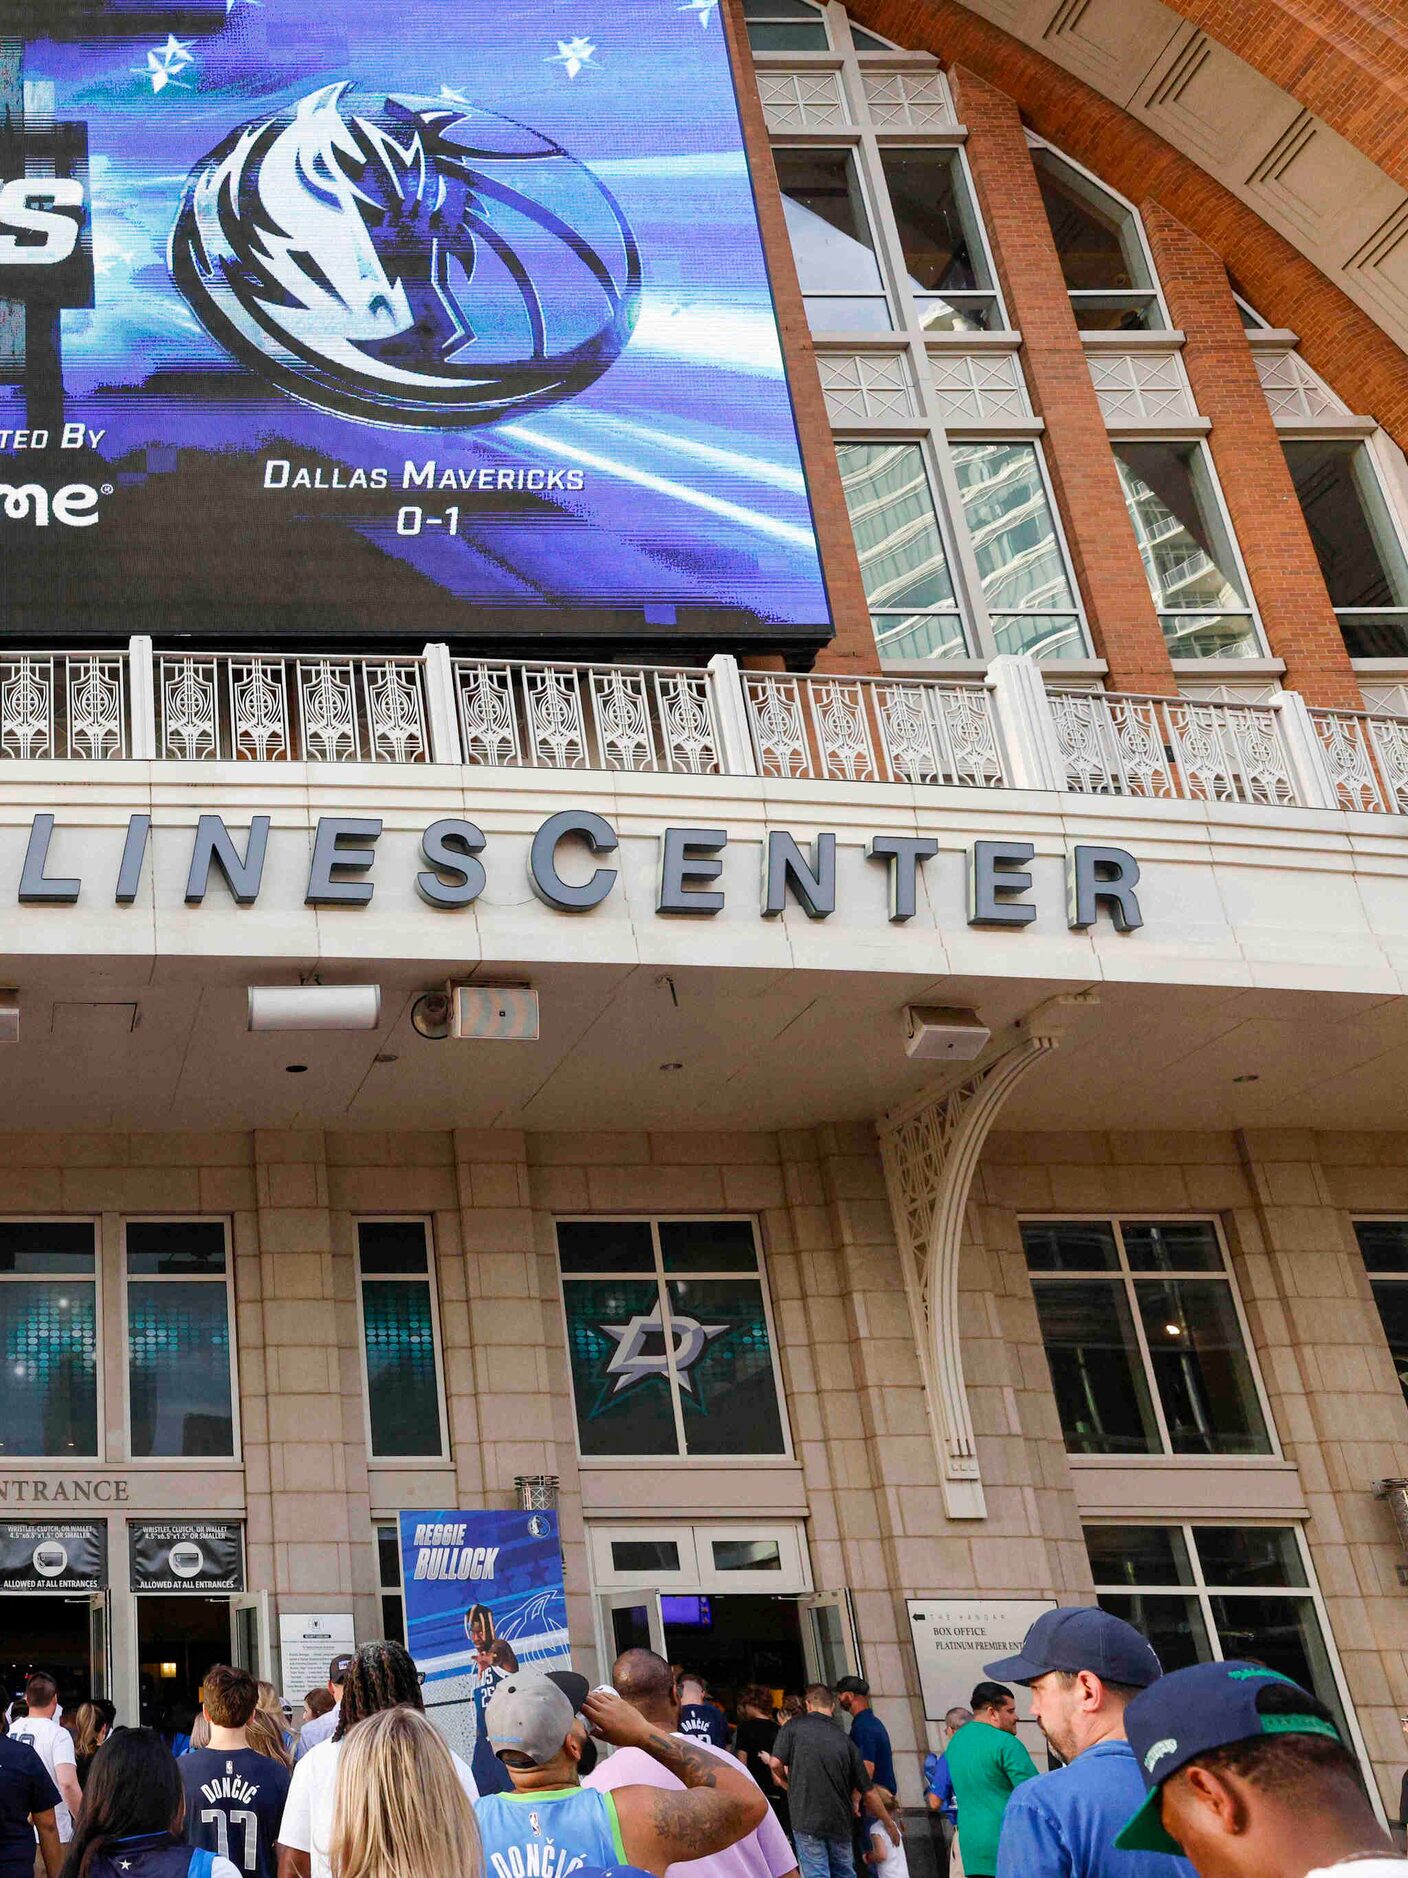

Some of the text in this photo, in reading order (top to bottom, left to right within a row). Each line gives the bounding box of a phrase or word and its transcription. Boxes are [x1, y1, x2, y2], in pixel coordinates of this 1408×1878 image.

[60, 422, 106, 449] BY
[263, 460, 585, 491] DALLAS MAVERICKS
[396, 506, 460, 536] 0-1
[527, 809, 1145, 932] CENTER
[413, 1524, 467, 1546] REGGIE
[413, 1548, 500, 1580] BULLOCK
[3, 1580, 98, 1588] ALLOWED AT ALL ENTRANCES
[140, 1581, 234, 1589] ALLOWED AT ALL ENTRANCES
[933, 1627, 987, 1636] BOX OFFICE
[936, 1641, 974, 1650] PLATINUM
[975, 1641, 1008, 1650] PREMIER
[200, 1774, 260, 1804] DONČIĆ
[201, 1809, 258, 1871] 77
